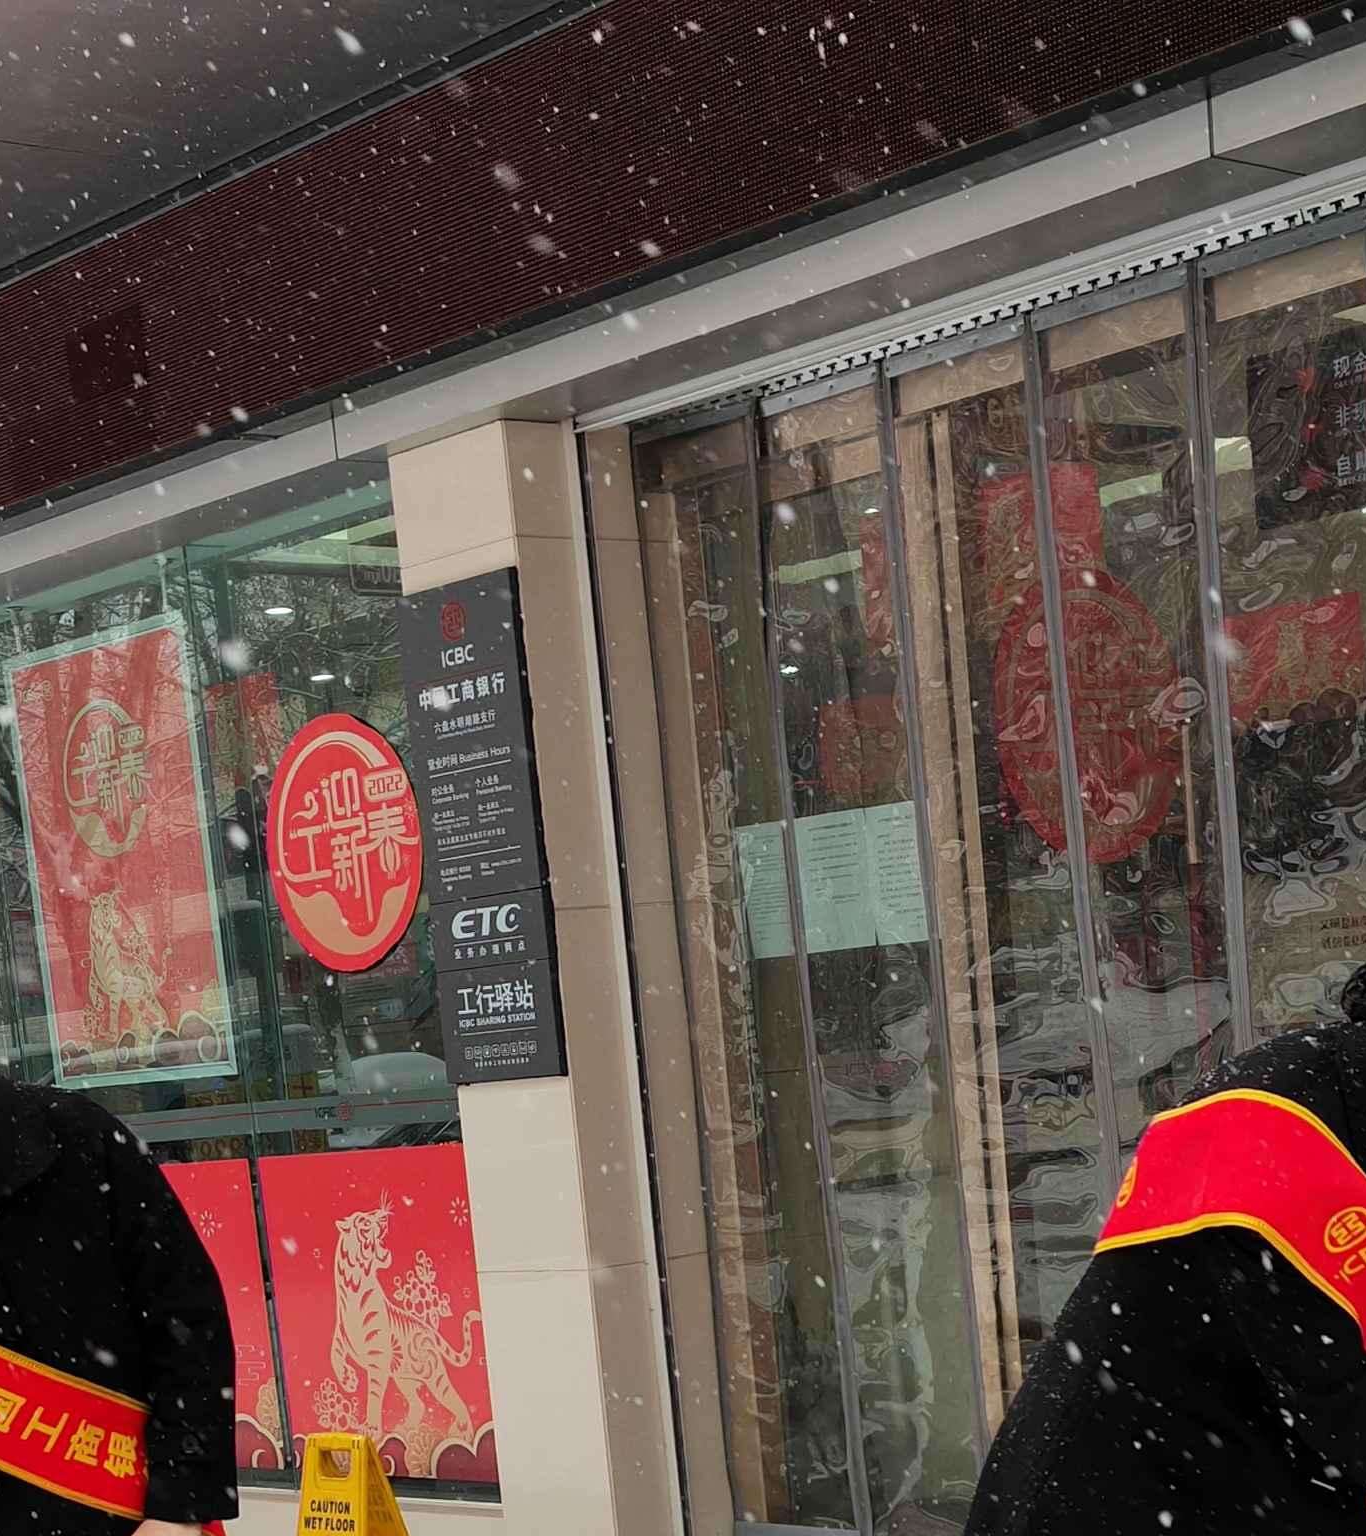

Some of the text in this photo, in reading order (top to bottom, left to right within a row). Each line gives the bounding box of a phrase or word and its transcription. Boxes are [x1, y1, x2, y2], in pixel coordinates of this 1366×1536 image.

[440, 643, 475, 669] ICBC
[489, 745, 511, 757] Hours
[366, 772, 407, 796] 2022
[451, 903, 522, 940] ETC
[456, 978, 535, 1015] 工行驿站
[458, 1011, 537, 1029] ICBC SHARING STATION
[310, 1499, 351, 1515] CAUTION
[303, 1516, 355, 1532] WET FLOOR
